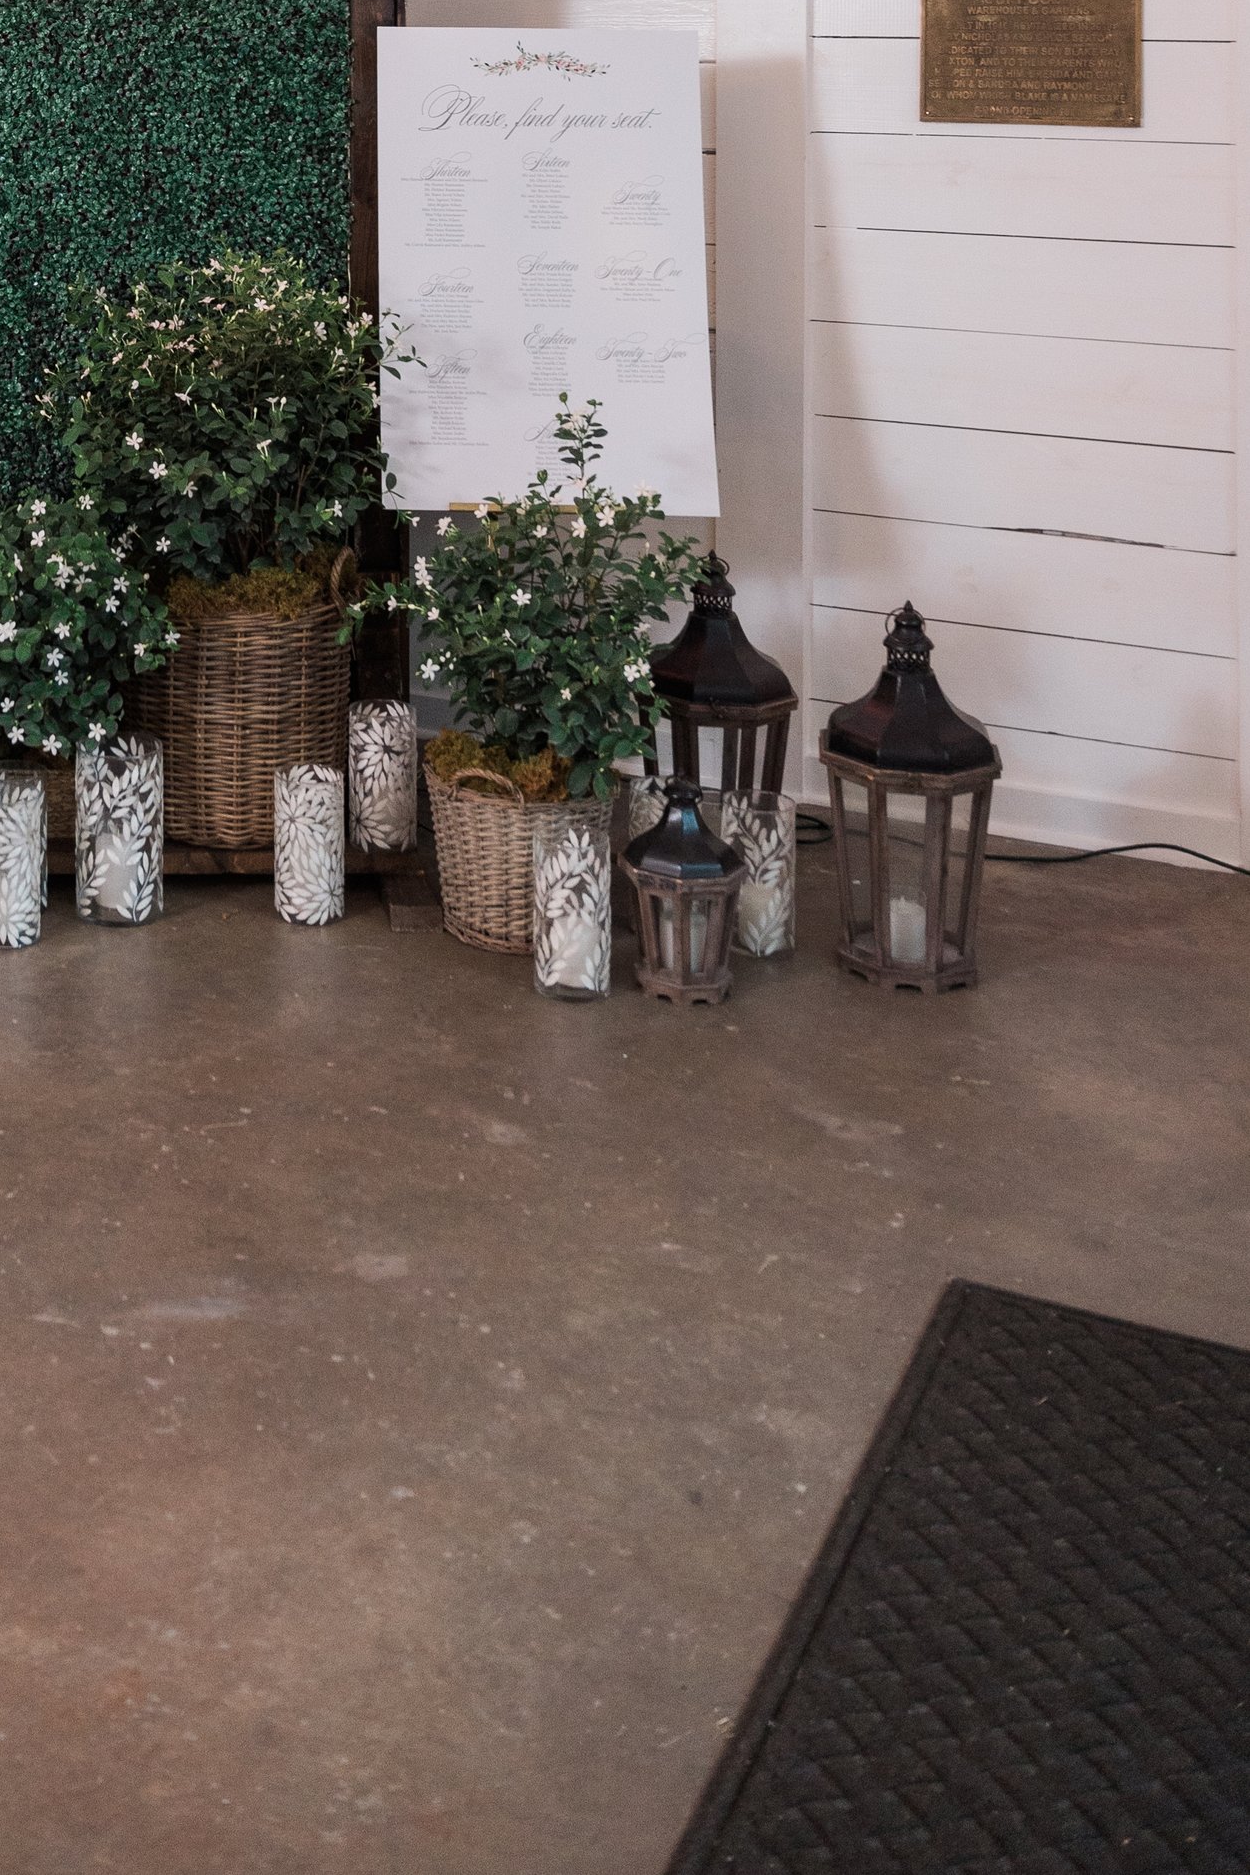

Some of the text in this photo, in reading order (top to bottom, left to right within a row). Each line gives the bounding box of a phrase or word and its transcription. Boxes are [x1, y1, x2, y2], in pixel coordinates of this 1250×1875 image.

[967, 6, 1029, 15] WAREHOUSE
[975, 68, 1004, 78] RAISE
[1072, 70, 1093, 79] AND
[1020, 80, 1042, 90] AND
[1043, 81, 1092, 91] RAYMOND
[1014, 92, 1048, 101] BLAKE
[1061, 93, 1069, 102] A
[504, 96, 564, 140] find
[549, 111, 607, 143] your
[611, 108, 663, 129] seat.
